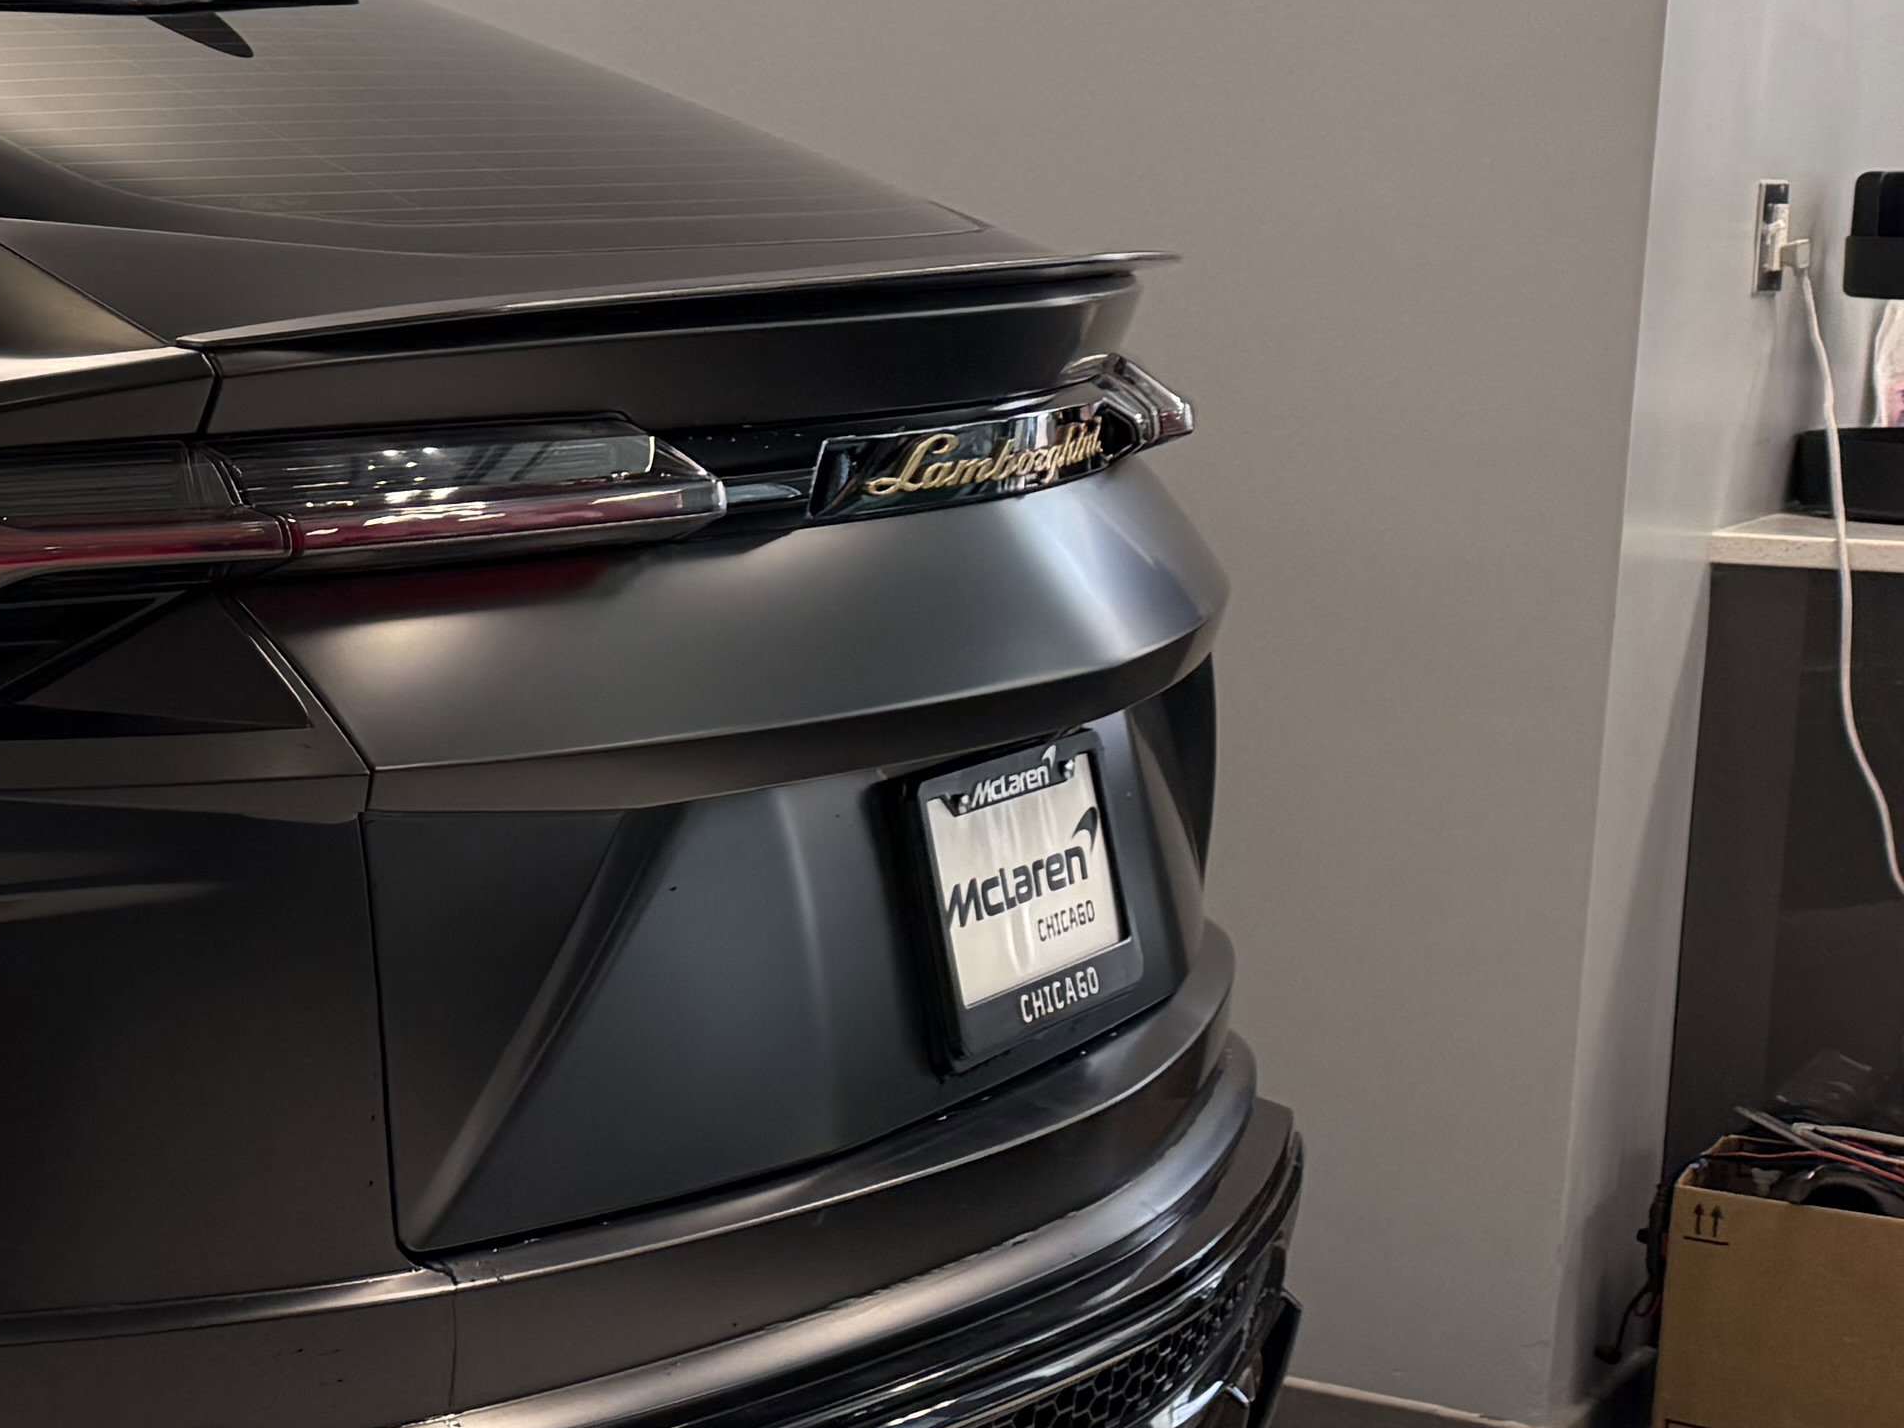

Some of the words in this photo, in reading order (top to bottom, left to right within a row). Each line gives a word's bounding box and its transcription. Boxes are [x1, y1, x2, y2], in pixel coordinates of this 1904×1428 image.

[972, 767, 1050, 808] McLaren
[947, 846, 1088, 928] McLaren
[1037, 899, 1096, 943] CHICAGO
[1020, 966, 1100, 1023] CHICAGO
